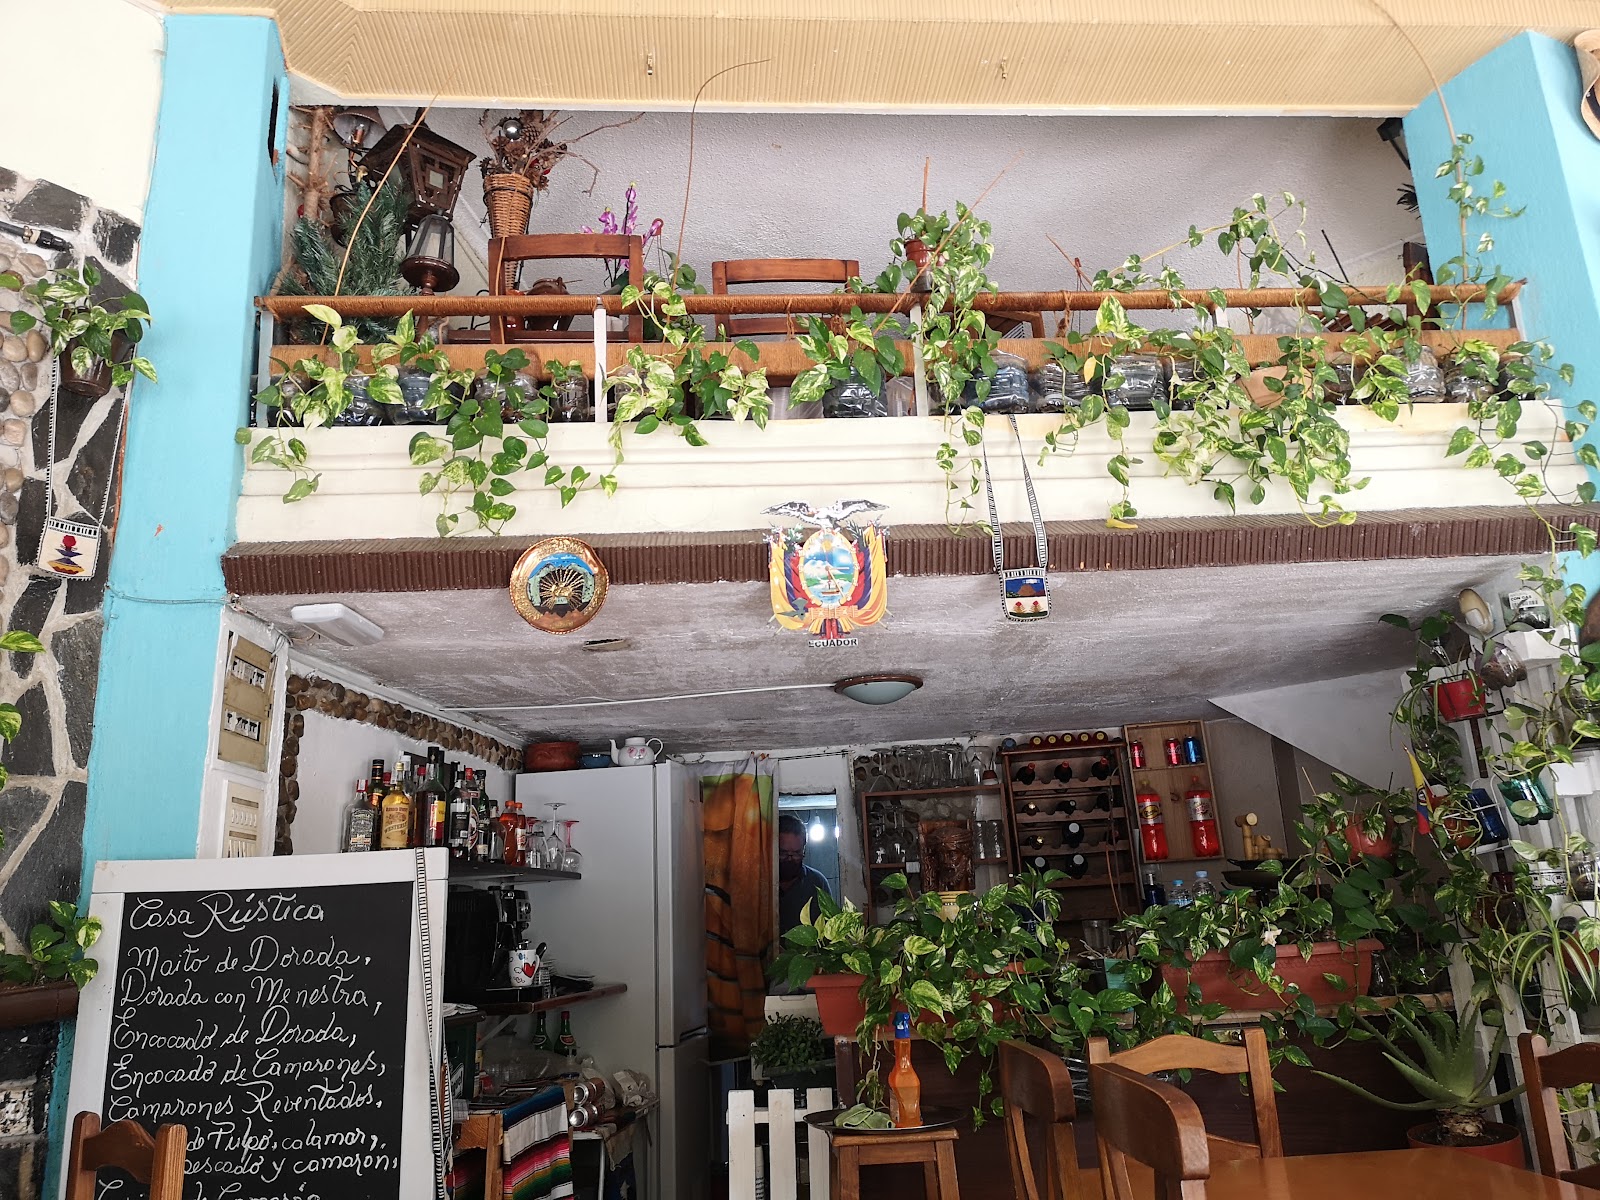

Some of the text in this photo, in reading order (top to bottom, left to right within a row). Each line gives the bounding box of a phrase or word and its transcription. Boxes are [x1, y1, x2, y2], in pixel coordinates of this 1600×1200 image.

[808, 638, 857, 648] ECUADOR
[129, 891, 325, 939] Casa Rústica
[127, 943, 210, 982] Maito
[214, 946, 239, 974] de
[120, 966, 209, 1007] Dorada
[214, 992, 246, 1013] con
[113, 1004, 357, 1051] Encocado de Dorada,
[110, 1047, 386, 1098] Encocado de Camarones,
[108, 1094, 234, 1123] Camarones
[186, 1125, 205, 1151] de
[260, 1157, 287, 1183] y
